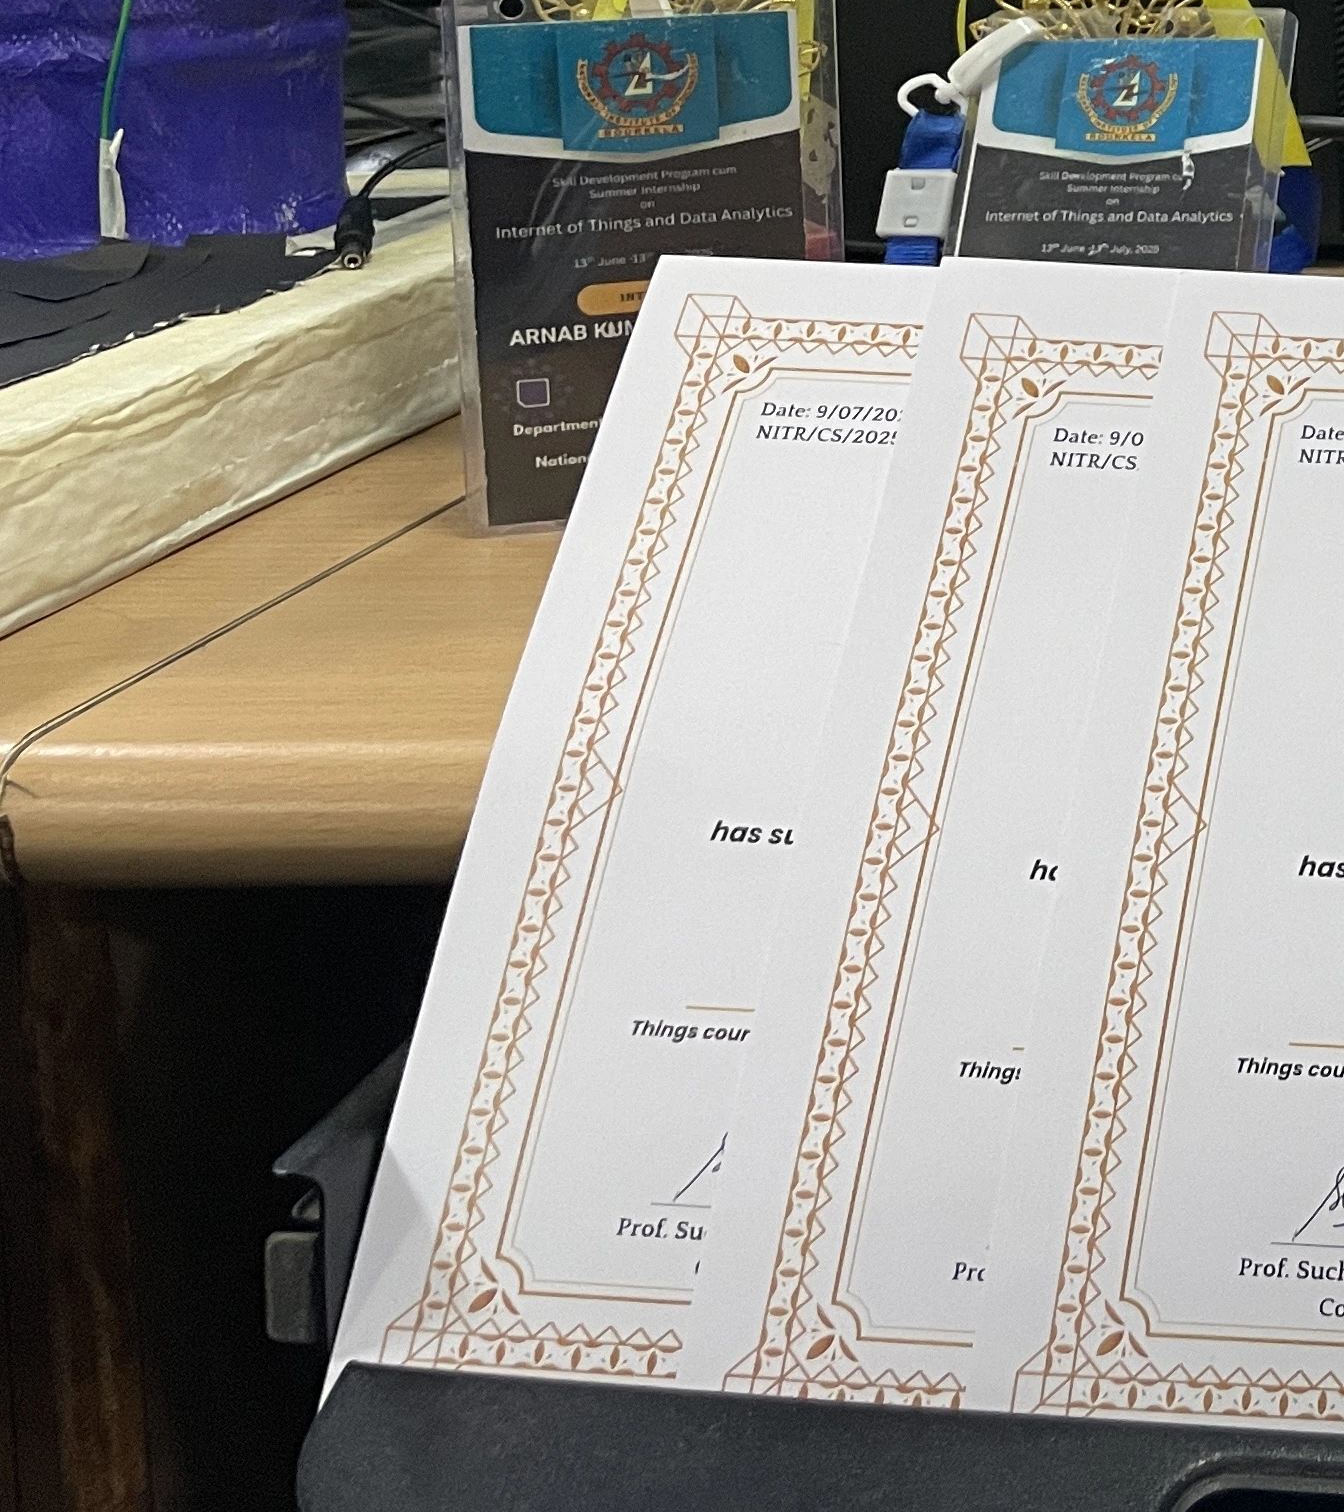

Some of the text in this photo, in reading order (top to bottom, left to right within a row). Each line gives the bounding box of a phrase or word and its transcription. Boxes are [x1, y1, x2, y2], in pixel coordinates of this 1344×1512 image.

[496, 204, 793, 240] Internet of Things and Data Analytics
[985, 209, 1233, 226] Internet of Things and Data Analytics
[510, 323, 588, 348] ARNAB
[1238, 1257, 1289, 1279] Prof.
